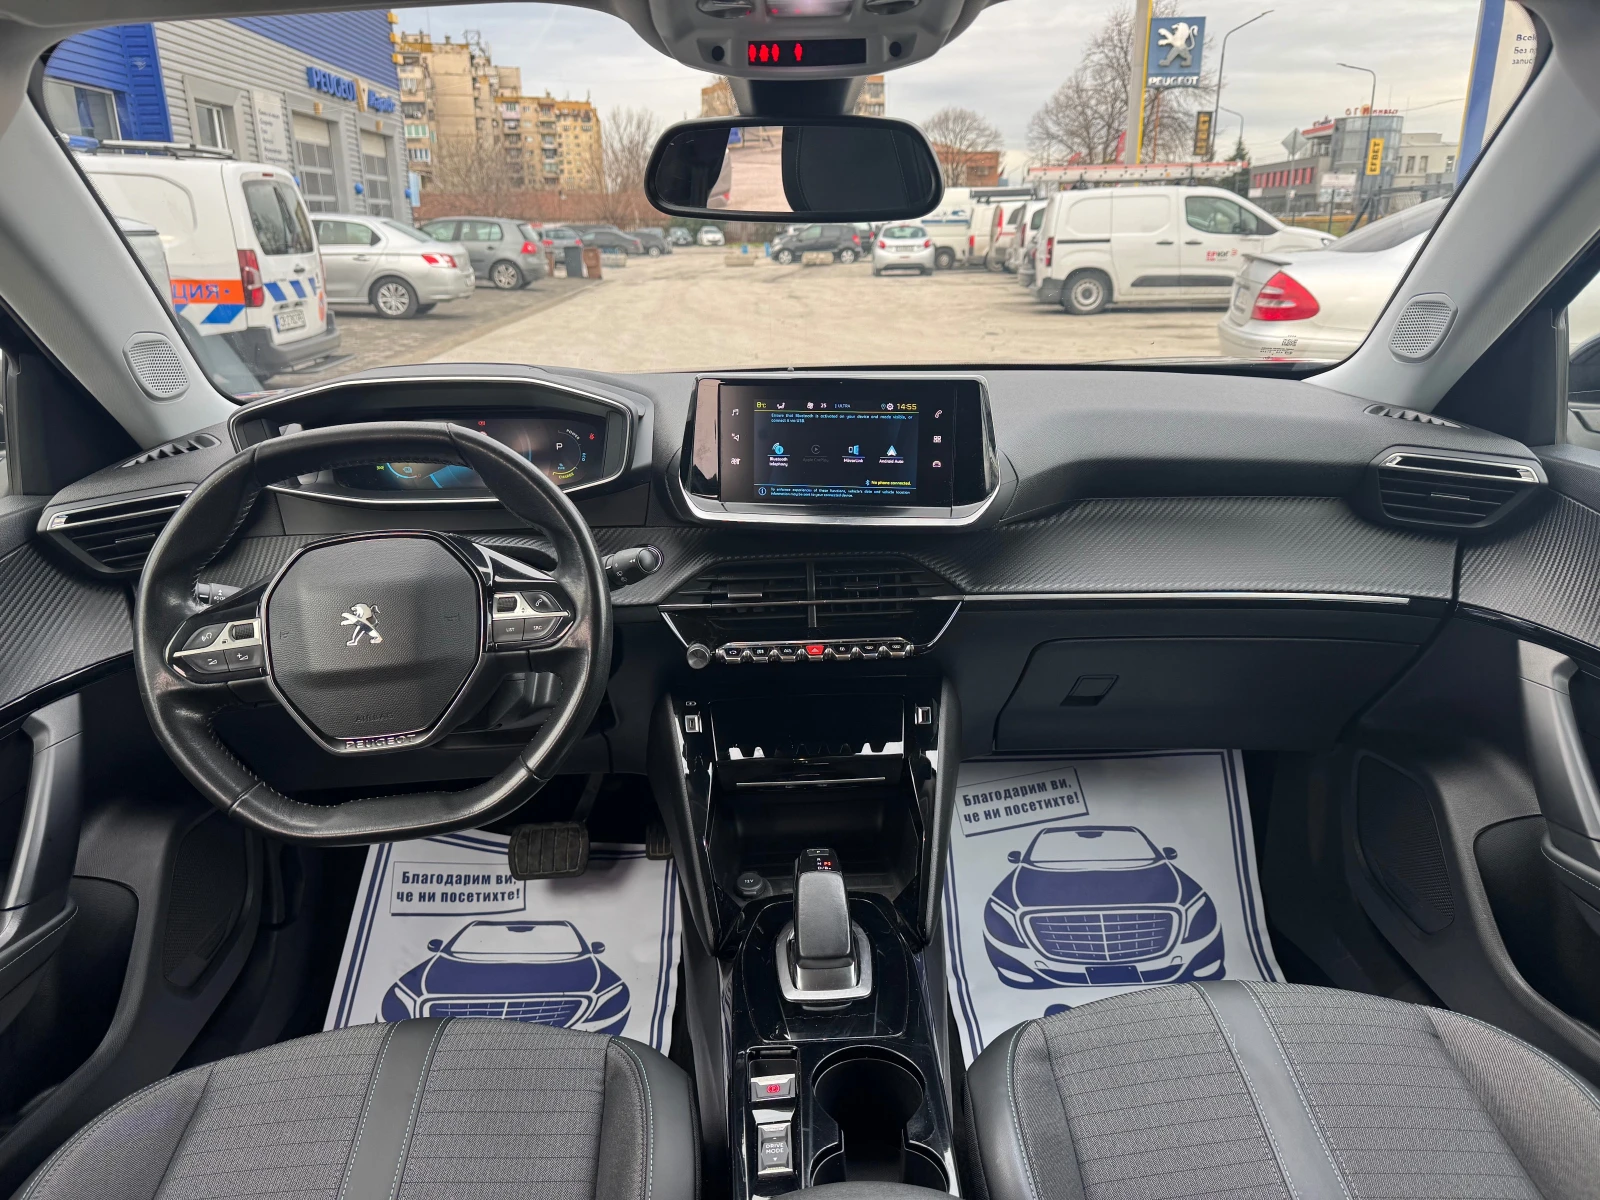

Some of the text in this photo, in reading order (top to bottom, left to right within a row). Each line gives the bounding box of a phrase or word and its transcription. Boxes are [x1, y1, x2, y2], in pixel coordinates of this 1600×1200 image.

[1148, 76, 1199, 86] PEUGEOT
[1369, 141, 1380, 172] EFBET
[566, 428, 580, 440] POWER
[344, 734, 416, 749] PEUGEOT
[962, 782, 1048, 806] Благодарим
[964, 792, 1080, 823] че ни посетихте!
[402, 871, 491, 886] Благодарим
[396, 888, 520, 903] че ни посетихте!
